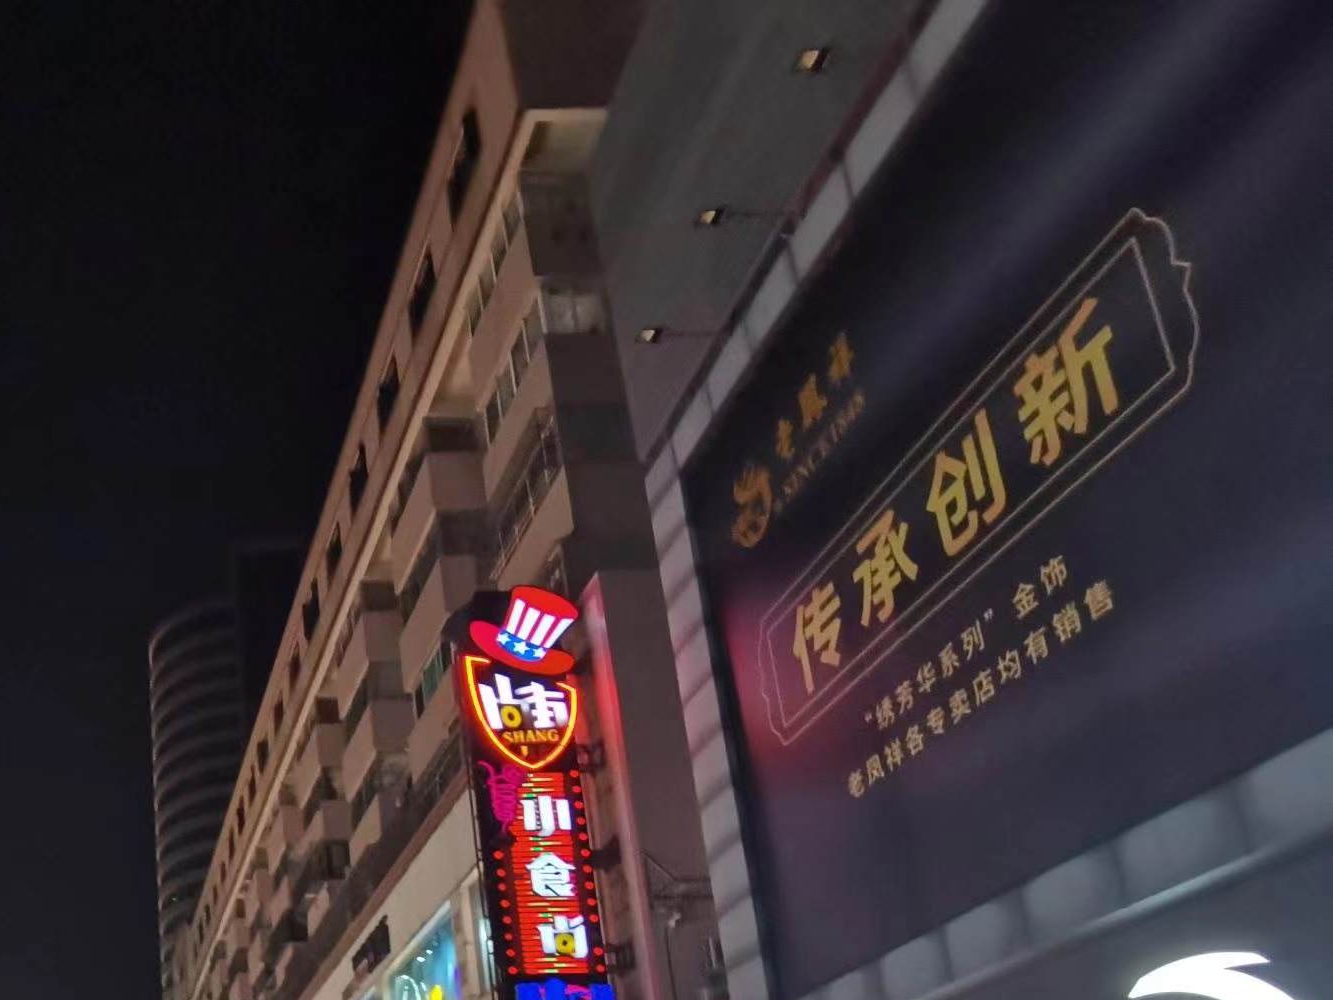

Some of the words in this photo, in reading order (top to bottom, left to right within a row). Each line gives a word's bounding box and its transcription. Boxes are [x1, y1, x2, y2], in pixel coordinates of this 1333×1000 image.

[793, 299, 1118, 694] 传承创新
[1013, 555, 1067, 619] 金饰
[502, 728, 559, 743] SHANG
[848, 579, 1111, 798] 老凤祥各专卖店均有销售
